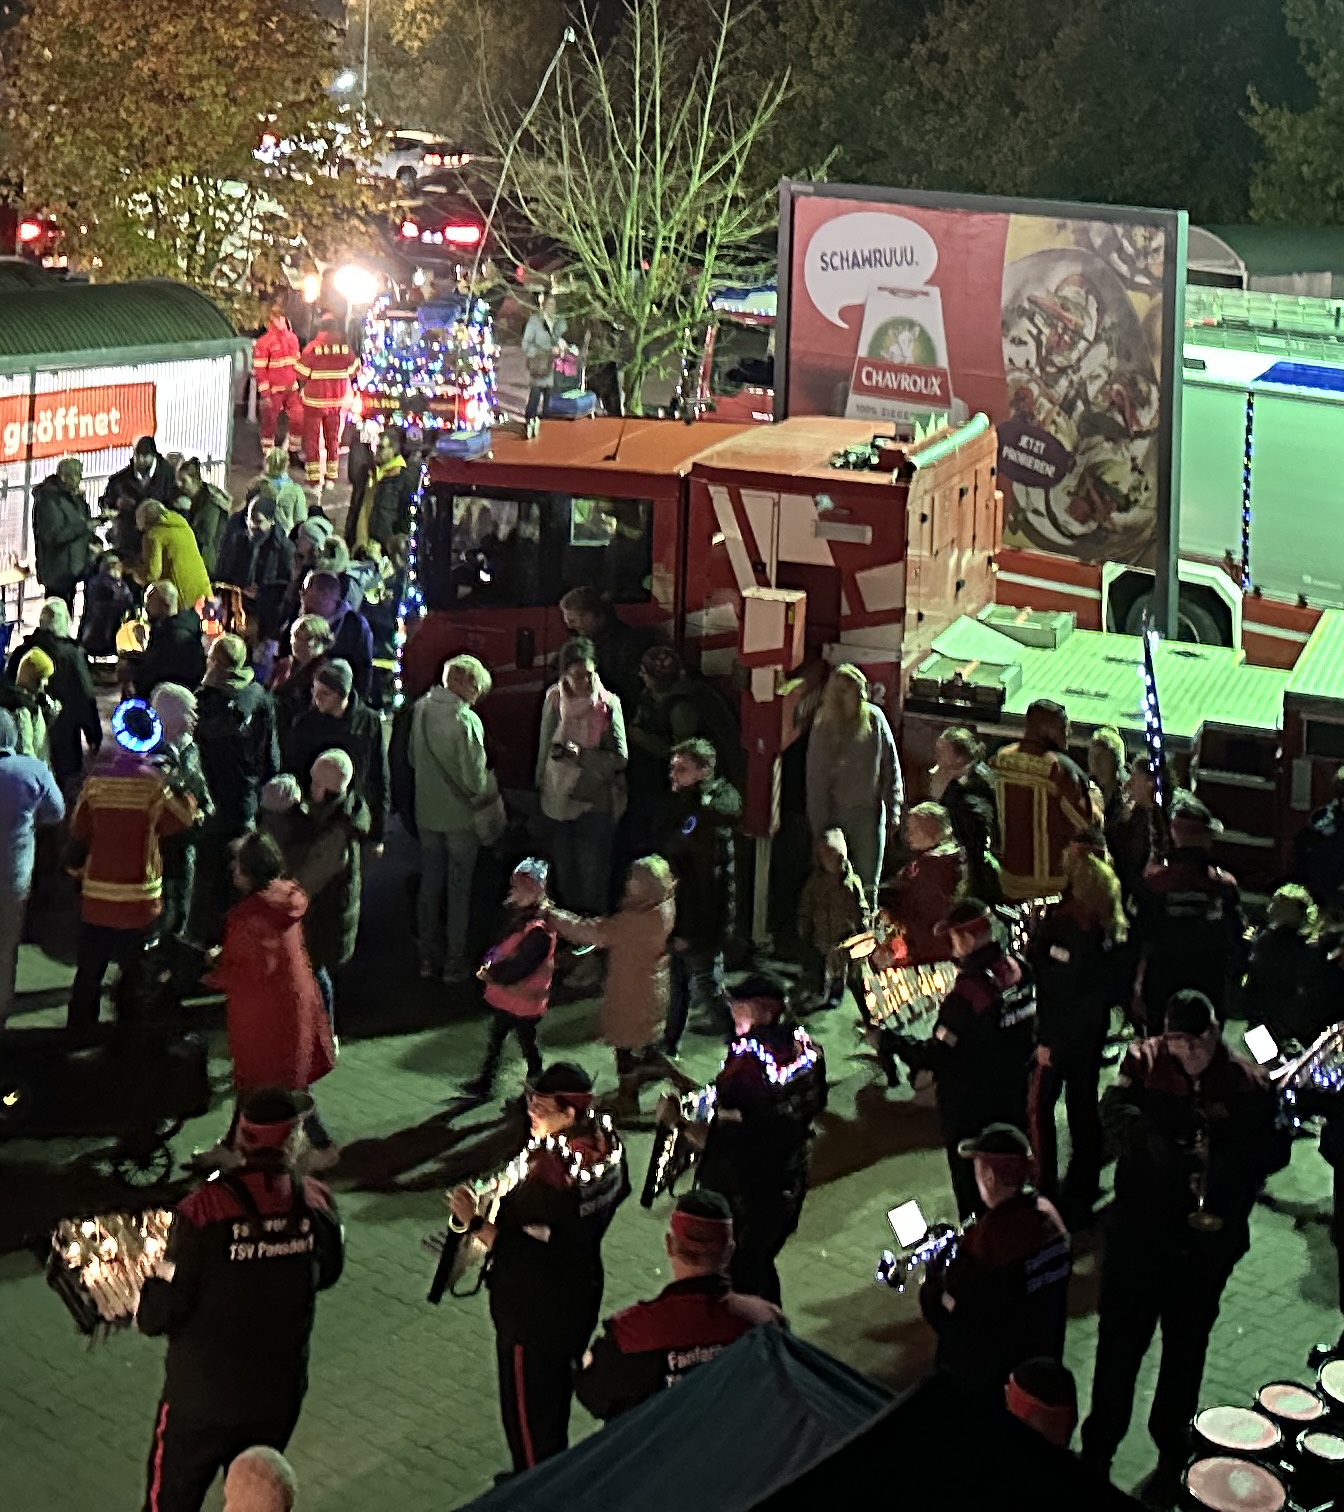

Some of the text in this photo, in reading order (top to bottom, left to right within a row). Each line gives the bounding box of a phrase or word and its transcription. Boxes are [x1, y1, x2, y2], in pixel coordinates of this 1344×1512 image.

[861, 366, 942, 396] CHAVROUX
[3, 405, 121, 457] geöffnet
[229, 1241, 256, 1261] TSV
